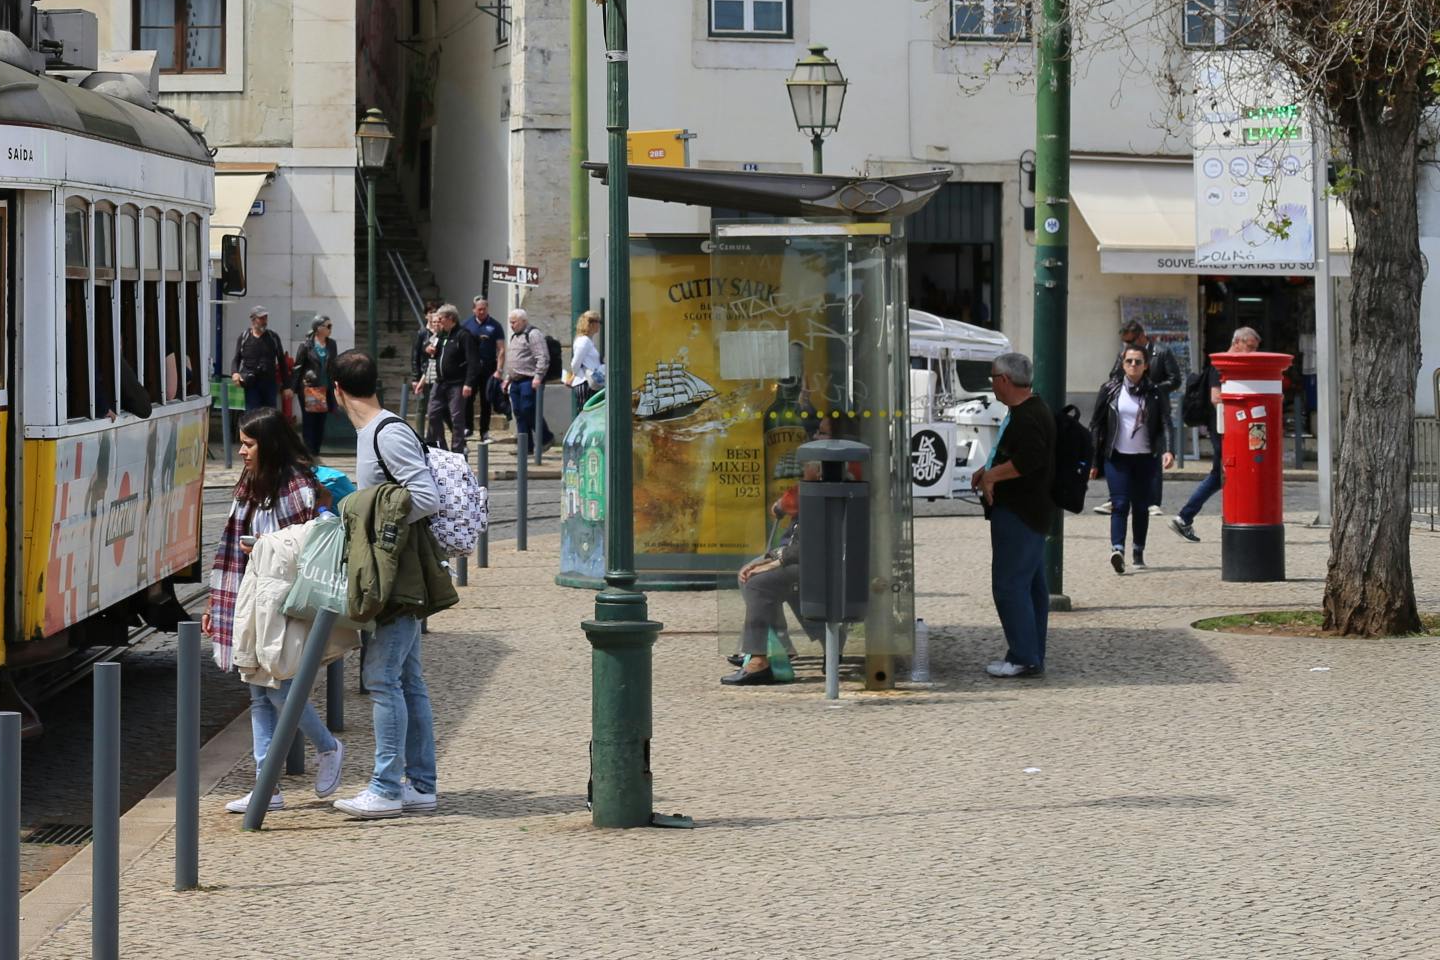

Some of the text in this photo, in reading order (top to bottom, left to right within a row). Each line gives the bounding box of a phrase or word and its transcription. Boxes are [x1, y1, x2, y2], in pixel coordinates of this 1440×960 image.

[8, 144, 34, 161] SAÍDA
[649, 149, 665, 158] 28E
[668, 278, 726, 303] CUTTY
[919, 435, 935, 453] LX
[727, 448, 760, 460] BEST
[912, 451, 944, 468] TUK
[712, 461, 760, 473] MIXED
[719, 474, 760, 486] SINCE
[735, 487, 760, 498] 1923
